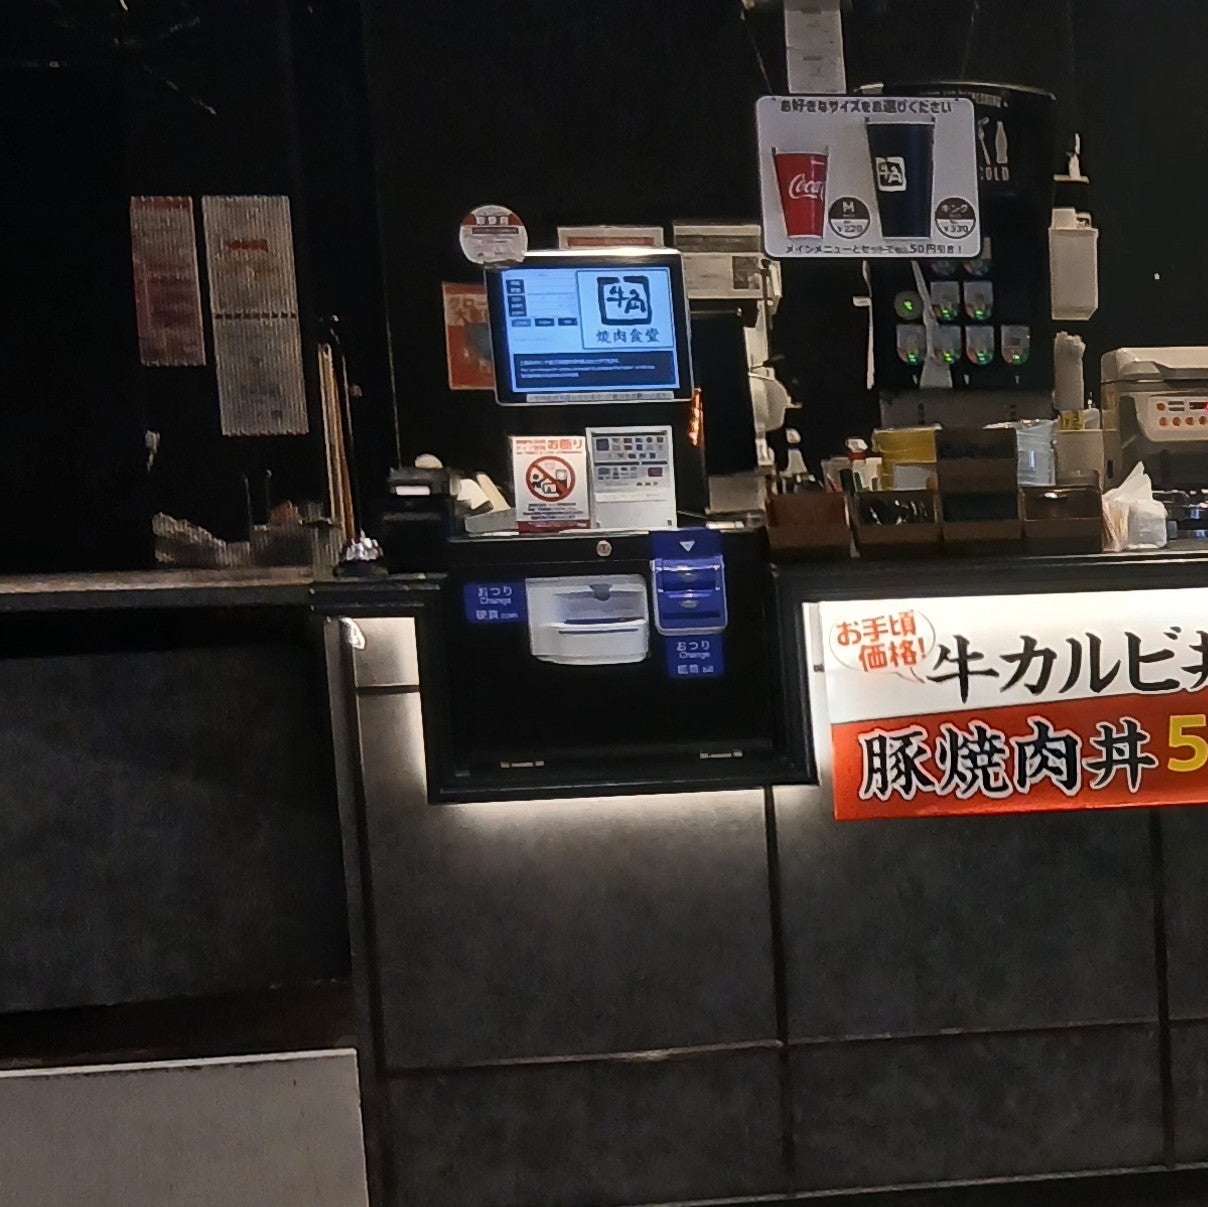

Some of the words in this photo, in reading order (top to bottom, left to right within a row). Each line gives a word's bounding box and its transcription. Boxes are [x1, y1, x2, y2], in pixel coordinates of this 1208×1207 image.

[780, 98, 952, 114] お好きなサイズをお選びください
[842, 201, 855, 213] M
[596, 327, 661, 344] 焼肉食堂
[836, 609, 917, 646] お手頃
[858, 636, 927, 673] 価格!
[858, 716, 1160, 800] 豚焼肉丼
